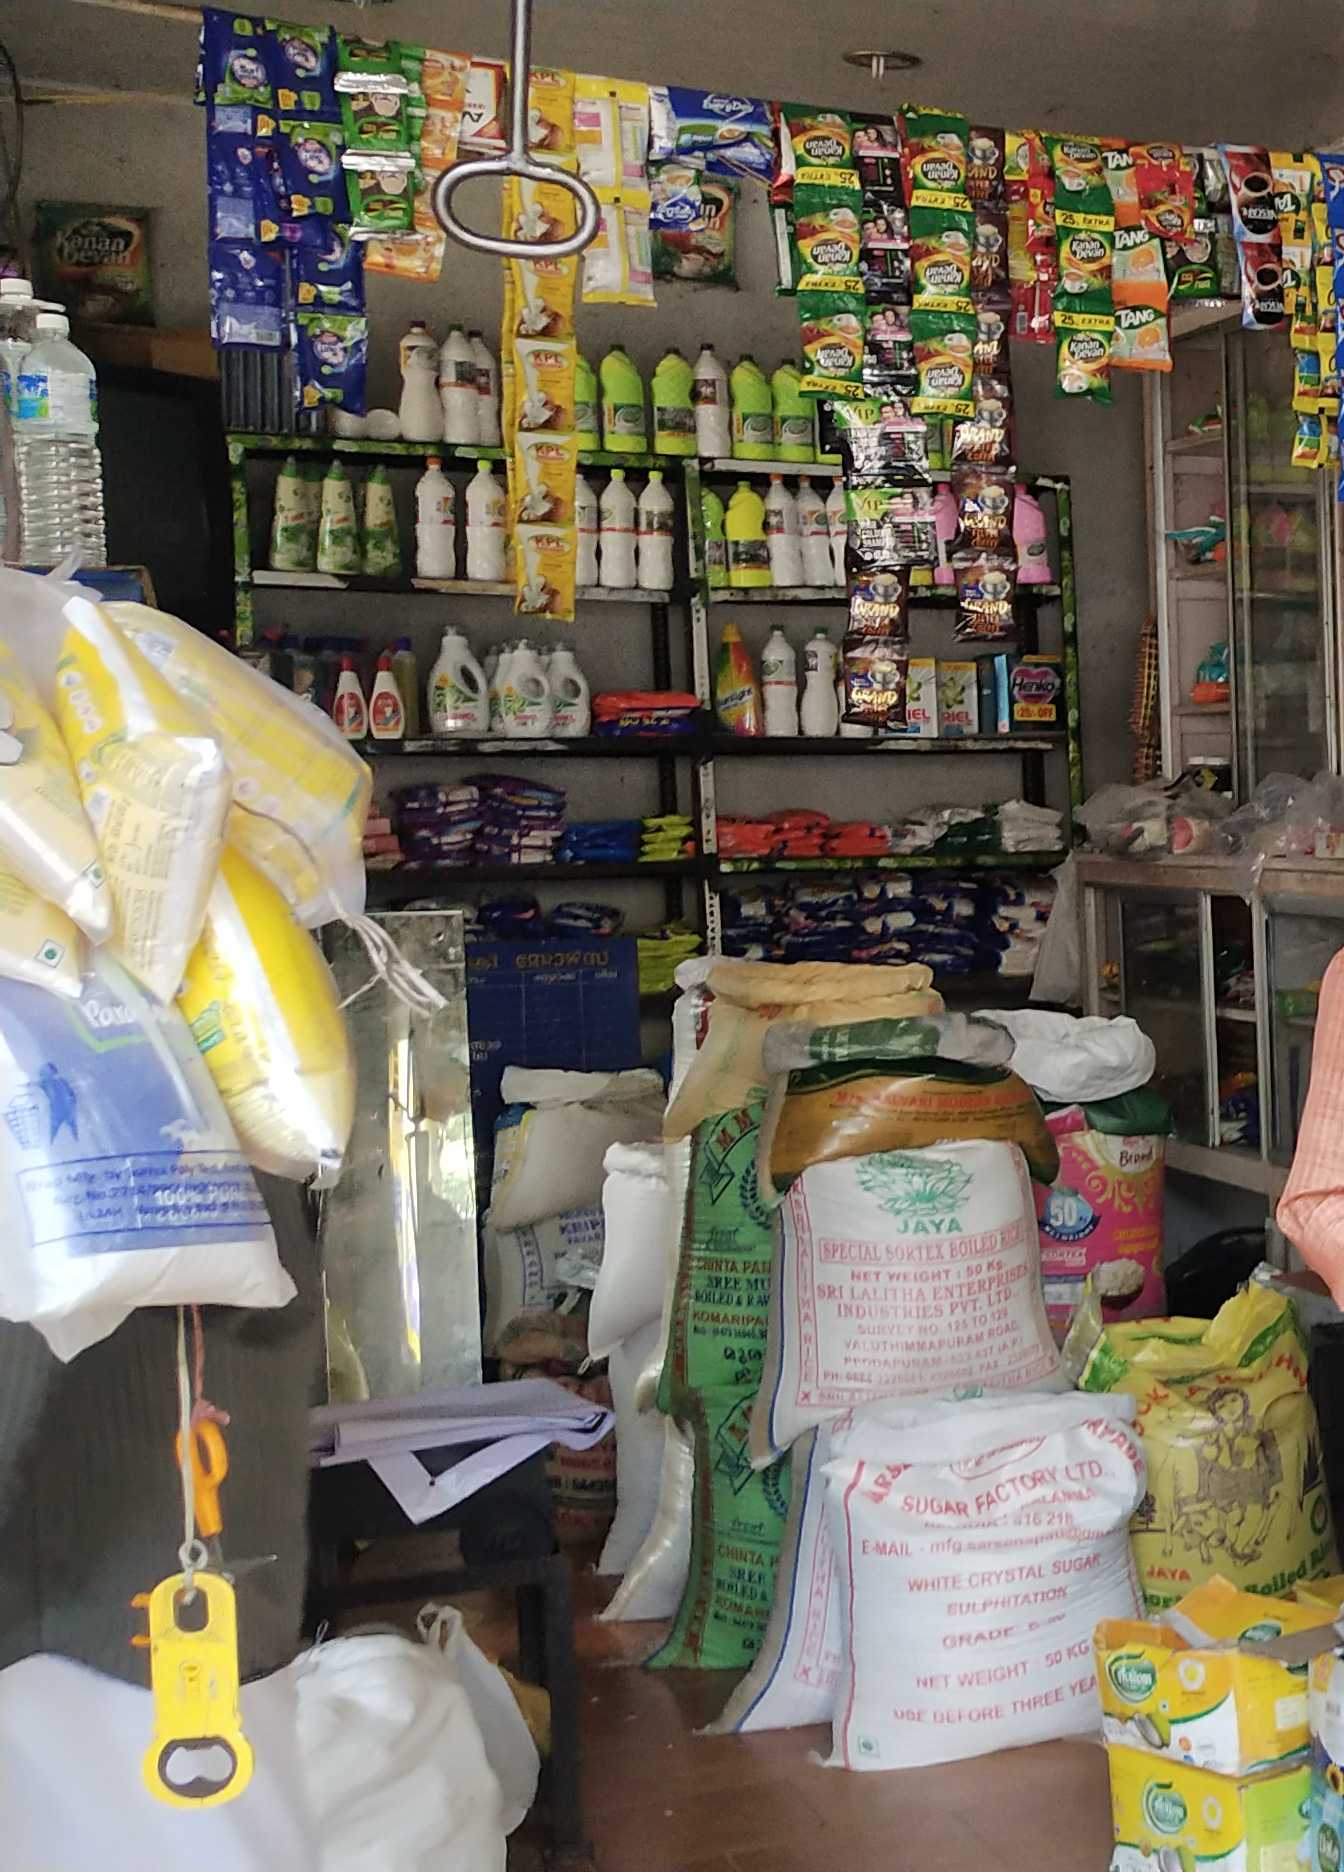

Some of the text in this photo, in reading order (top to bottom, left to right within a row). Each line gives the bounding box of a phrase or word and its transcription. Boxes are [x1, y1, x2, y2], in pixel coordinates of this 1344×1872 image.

[1071, 240, 1101, 252] Kanan
[1114, 230, 1149, 248] TANG
[1075, 247, 1106, 259] Devan
[1118, 310, 1154, 328] TANG
[1070, 340, 1100, 352] Kanan
[1075, 347, 1104, 360] Devan
[532, 352, 563, 363] KPL
[534, 445, 564, 456] KPL
[534, 537, 564, 547] KPL
[1011, 675, 1058, 694] Henko
[1050, 1196, 1078, 1227] 50
[896, 1217, 963, 1236] JAYA
[822, 1241, 883, 1262] SPECIAL
[950, 1230, 999, 1259] BOILED
[816, 1264, 1030, 1301] SRI LALITHA ENTERPRISES
[850, 1269, 881, 1283] NET
[887, 1267, 951, 1283] WEIGHT
[837, 1299, 945, 1319] INDUSTRIES
[901, 1495, 970, 1517] SUGAR
[974, 1466, 1058, 1514] FACTORY
[861, 1539, 913, 1558] E-MAIL
[908, 1552, 1102, 1593] WHITE CRYSTAL SUGAR
[1146, 1565, 1192, 1582] JAYA
[946, 1586, 1069, 1617] SULPHITATION
[942, 1627, 1017, 1649] GRADE
[916, 1640, 1090, 1689] NET WEIGHT 50 KG
[893, 1708, 924, 1723] USE
[932, 1704, 1003, 1724] BEFORE
[1011, 1689, 1064, 1714] THREE
